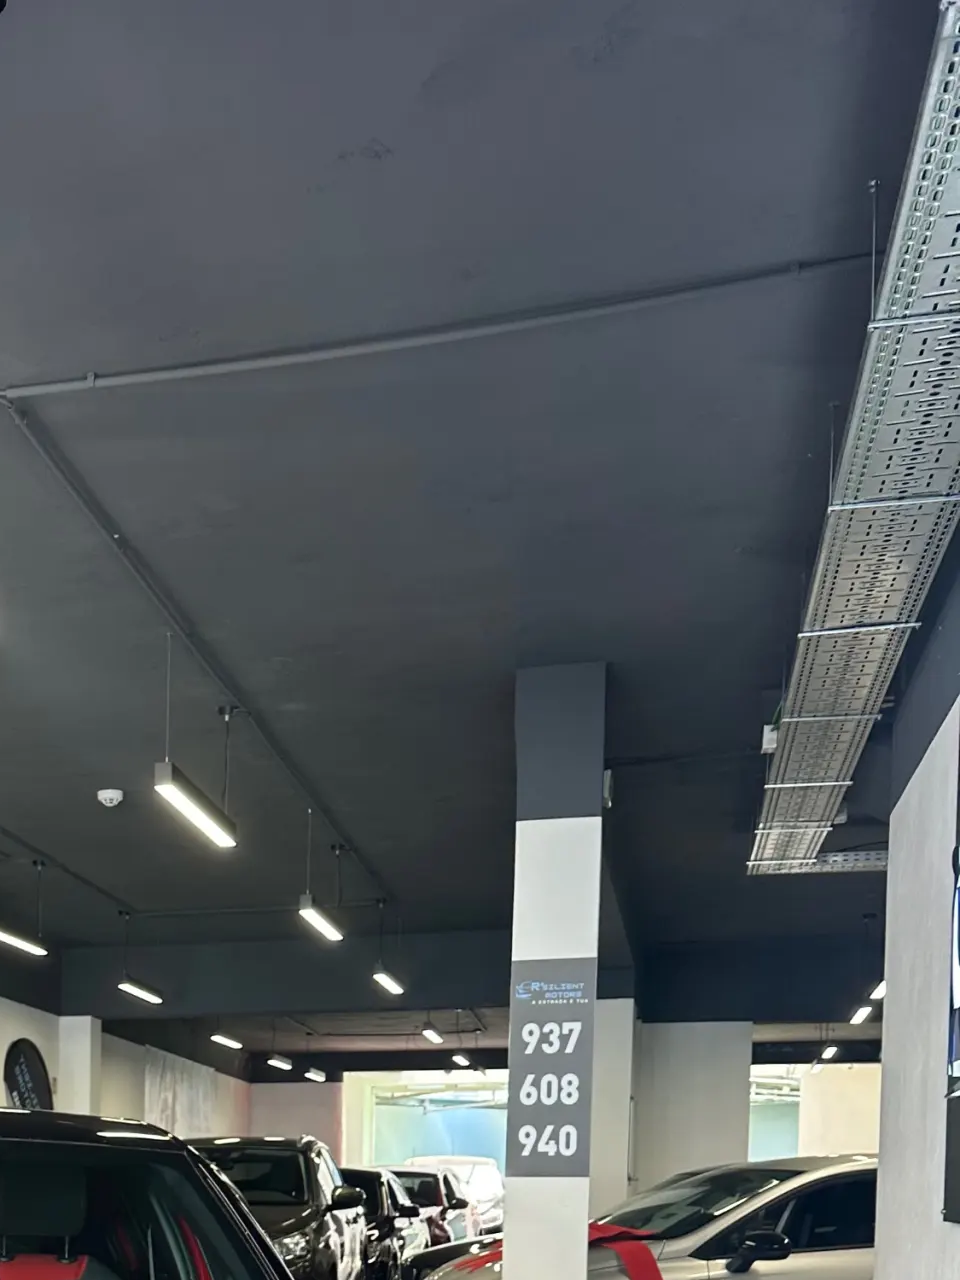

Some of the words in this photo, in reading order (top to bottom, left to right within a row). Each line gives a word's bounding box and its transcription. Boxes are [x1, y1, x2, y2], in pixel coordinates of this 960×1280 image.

[521, 1022, 582, 1054] 937
[520, 1073, 579, 1105] 608
[518, 1125, 577, 1156] 940
